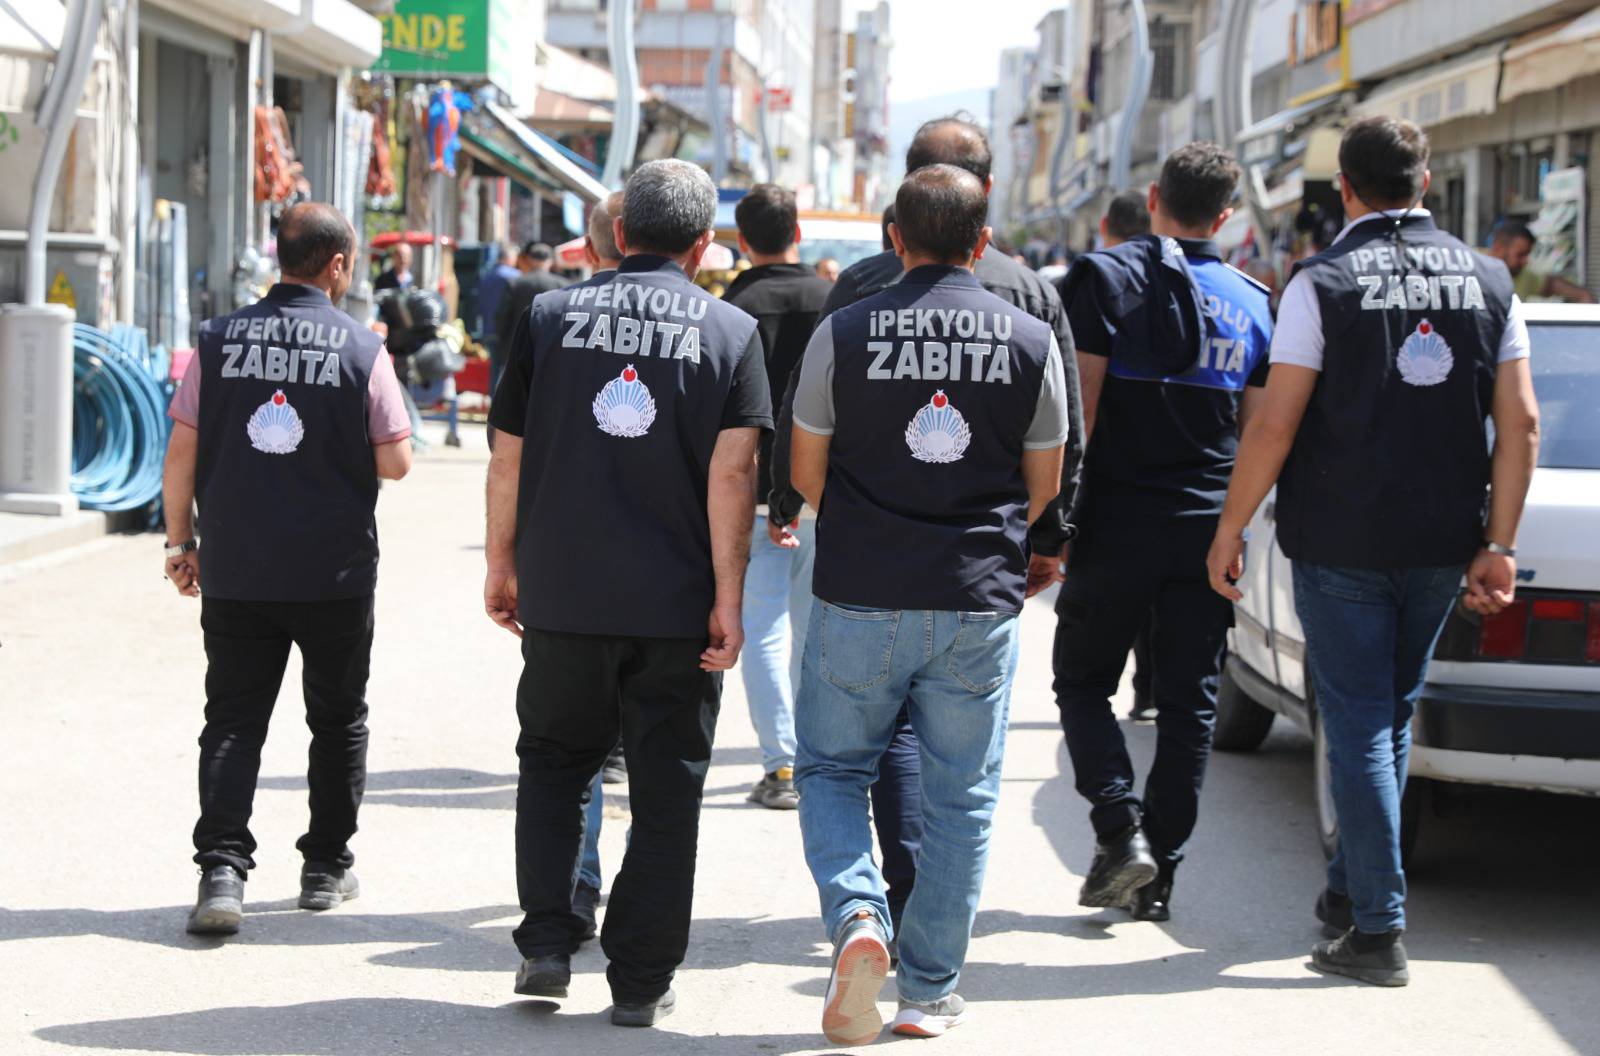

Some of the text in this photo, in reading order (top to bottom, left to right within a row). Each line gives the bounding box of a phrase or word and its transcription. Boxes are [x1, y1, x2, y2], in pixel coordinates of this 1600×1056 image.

[1357, 275, 1487, 311] ZABITA
[561, 311, 701, 365] ZABITA
[221, 343, 342, 388] ZABITA
[866, 340, 1013, 385] ZABITA
